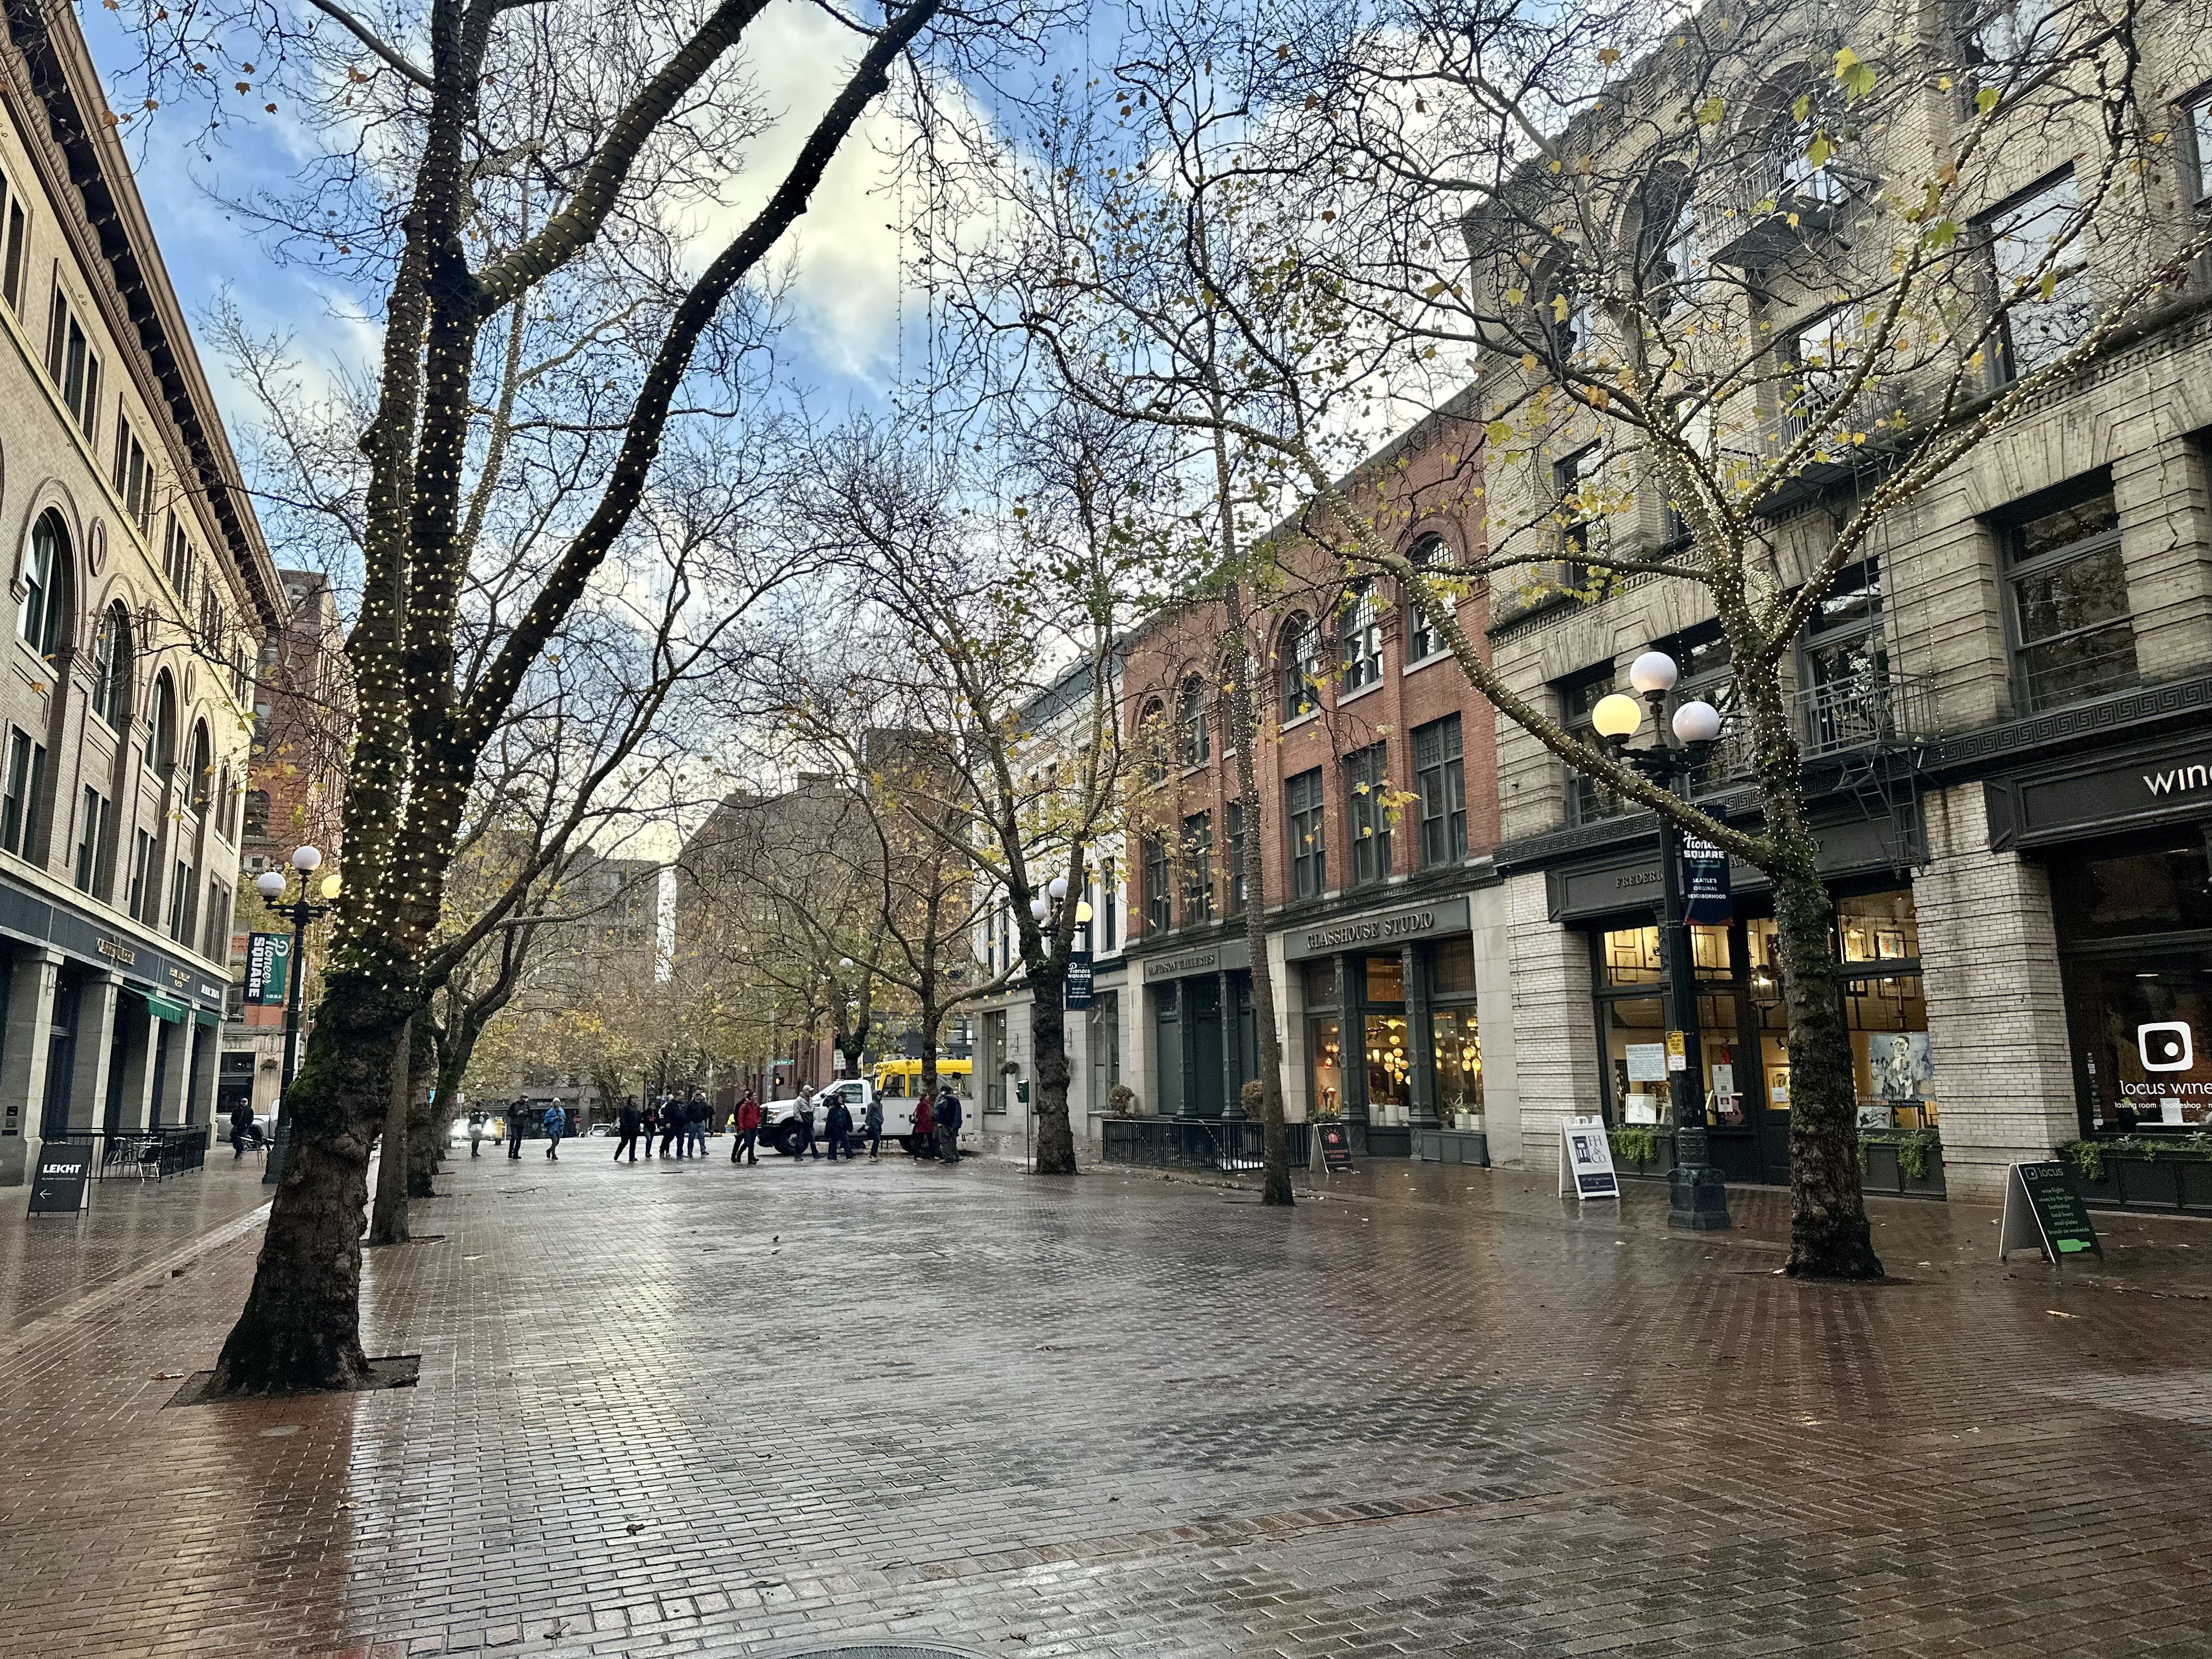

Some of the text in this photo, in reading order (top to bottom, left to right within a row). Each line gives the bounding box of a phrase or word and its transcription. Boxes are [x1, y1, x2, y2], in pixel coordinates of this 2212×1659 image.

[1684, 850, 1725, 859] SQUARE
[1307, 911, 1434, 949] GLASSHOUSE STUDIO
[248, 936, 265, 997] SQUARE
[262, 937, 289, 985] Pioneer
[1068, 962, 1090, 973] Pioneer
[2119, 1080, 2212, 1094] locus wine
[2115, 1102, 2137, 1110] tasting
[2163, 1101, 2201, 1110] bottleshop
[1588, 1135, 1602, 1147] FH
[1594, 1146, 1601, 1154] &
[43, 1164, 81, 1173] LEICHT
[2038, 1167, 2063, 1177] locus
